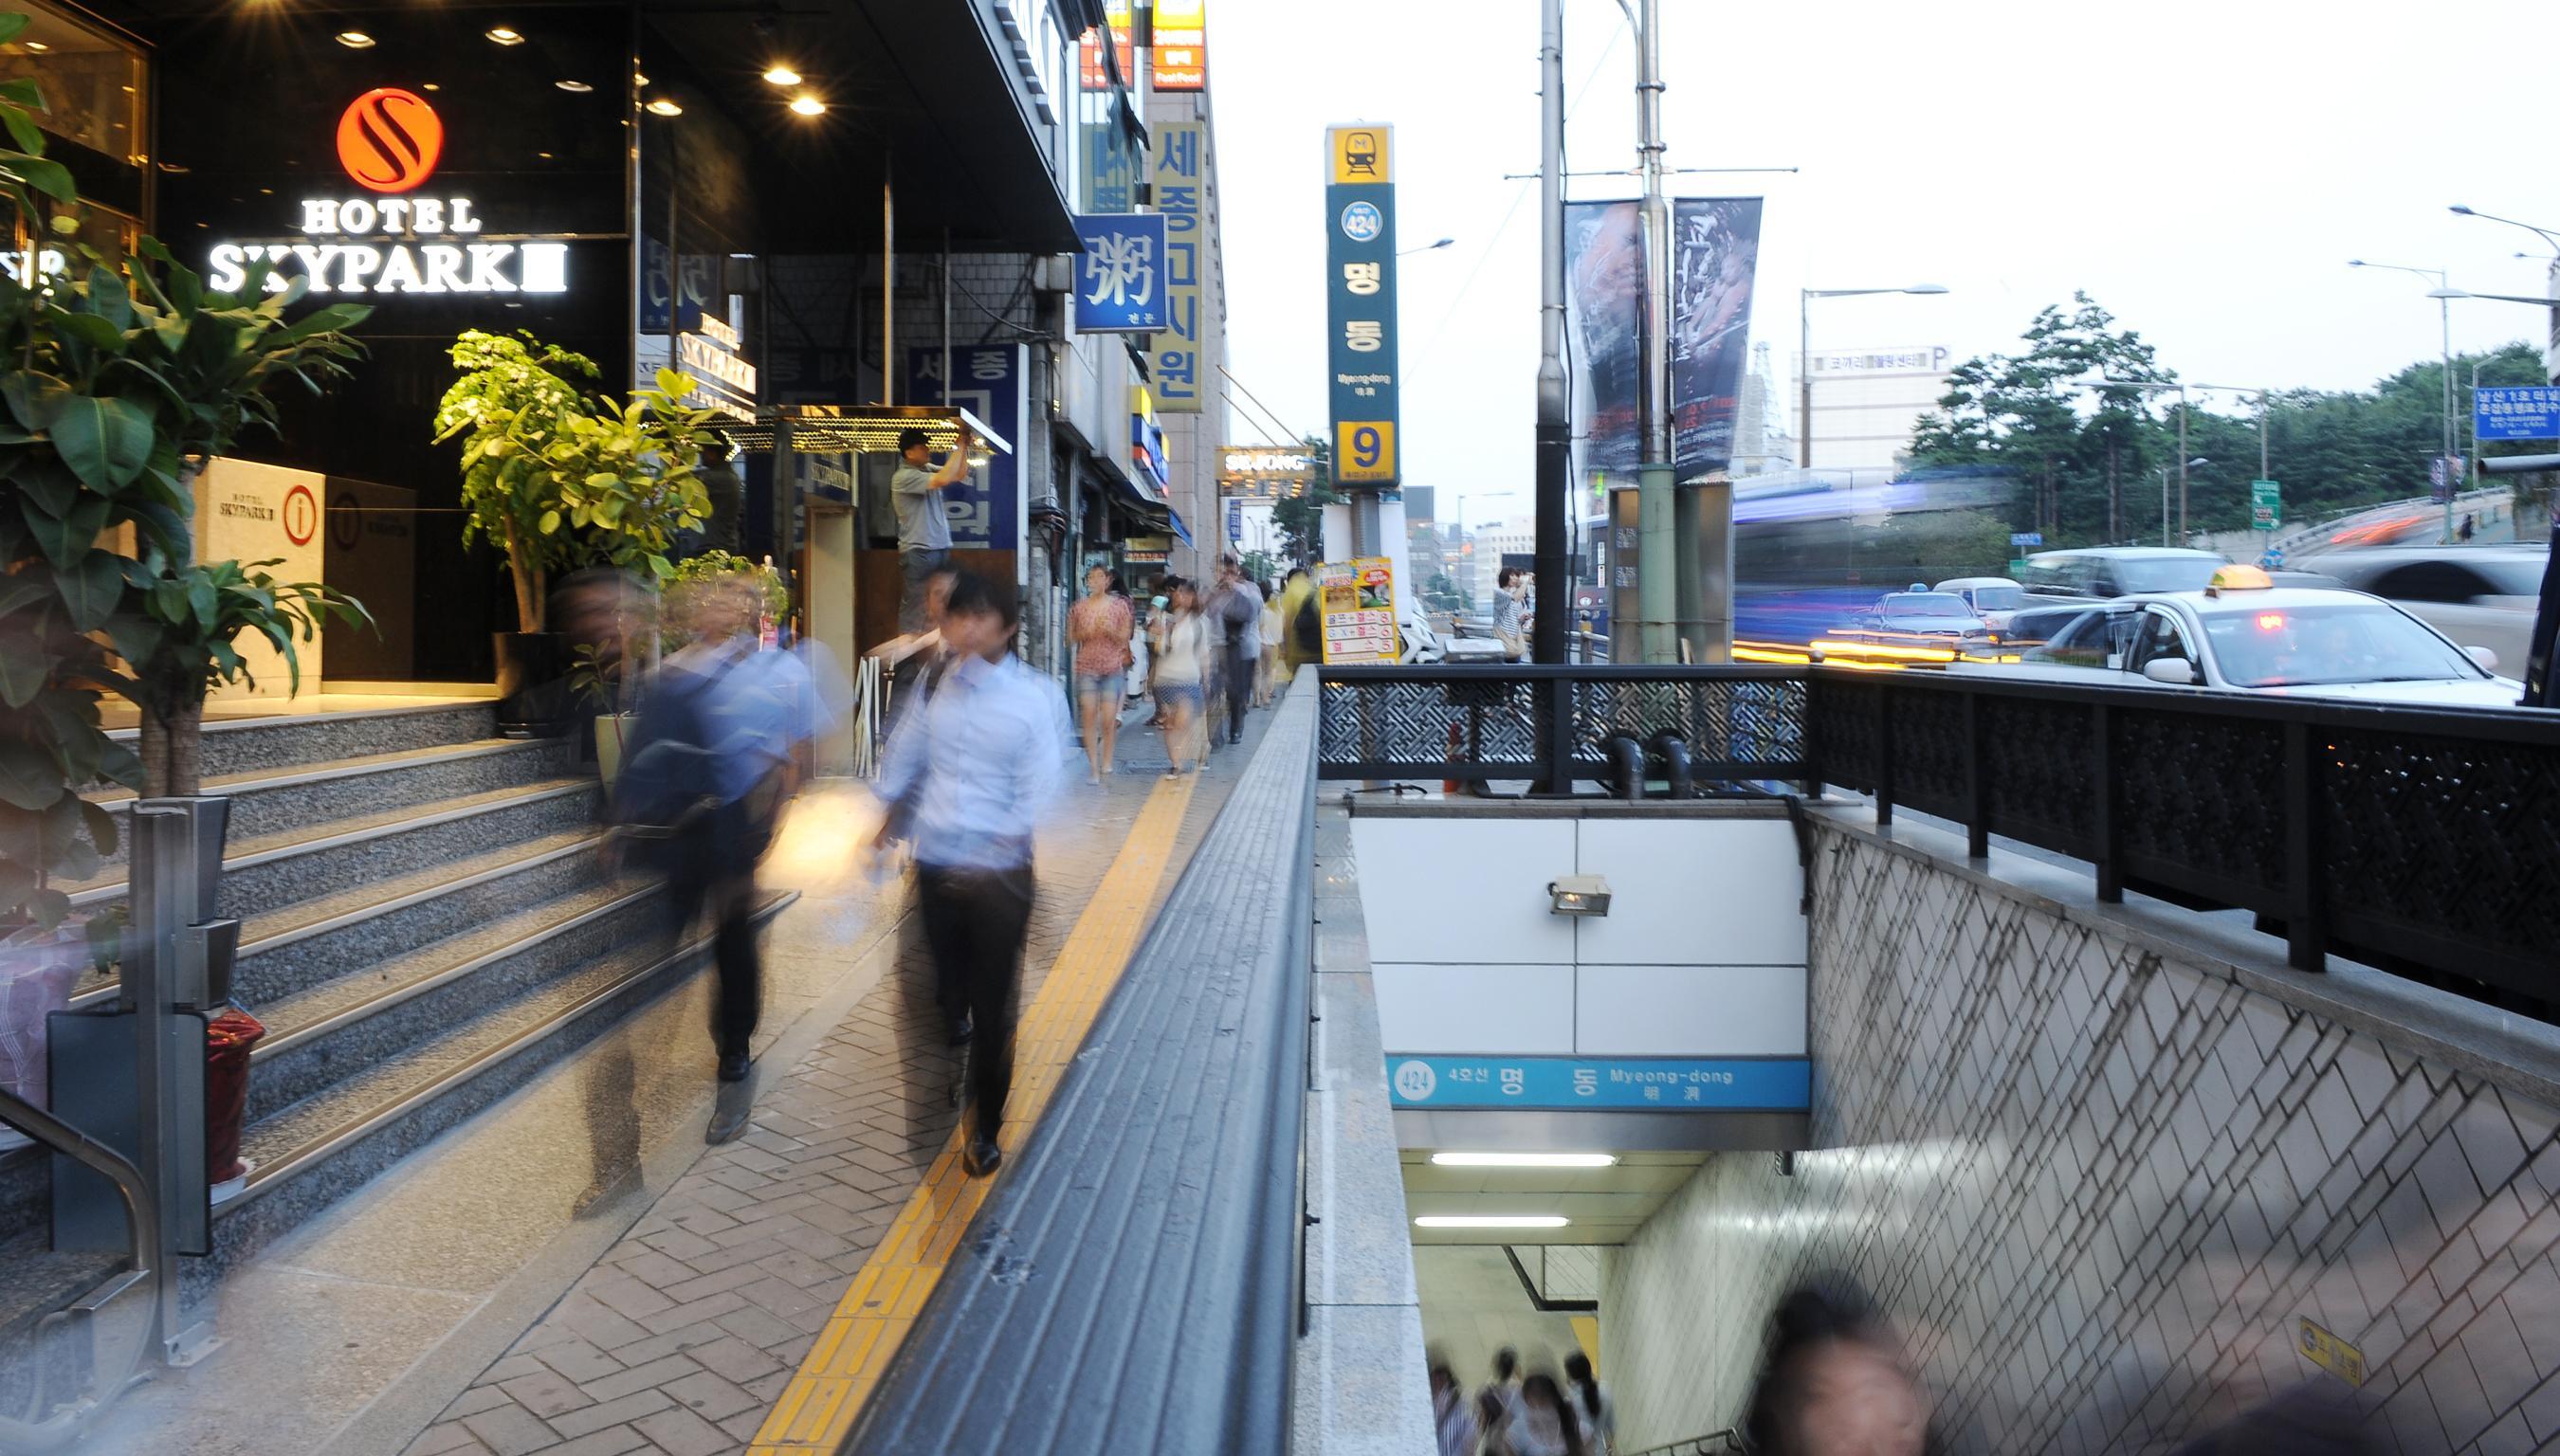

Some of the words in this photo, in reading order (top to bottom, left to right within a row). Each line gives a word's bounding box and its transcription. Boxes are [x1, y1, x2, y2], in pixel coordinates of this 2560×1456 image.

[301, 198, 483, 234] HOTEL
[1346, 215, 1377, 233] 424
[209, 244, 519, 293] SKYPARK
[1085, 231, 1154, 307] 粥
[1932, 347, 1947, 371] P
[1353, 427, 1381, 468] 9
[1402, 1070, 1429, 1091] 424
[1449, 1067, 1489, 1083] 4호선
[1610, 1068, 1733, 1084] Myeong-dong
